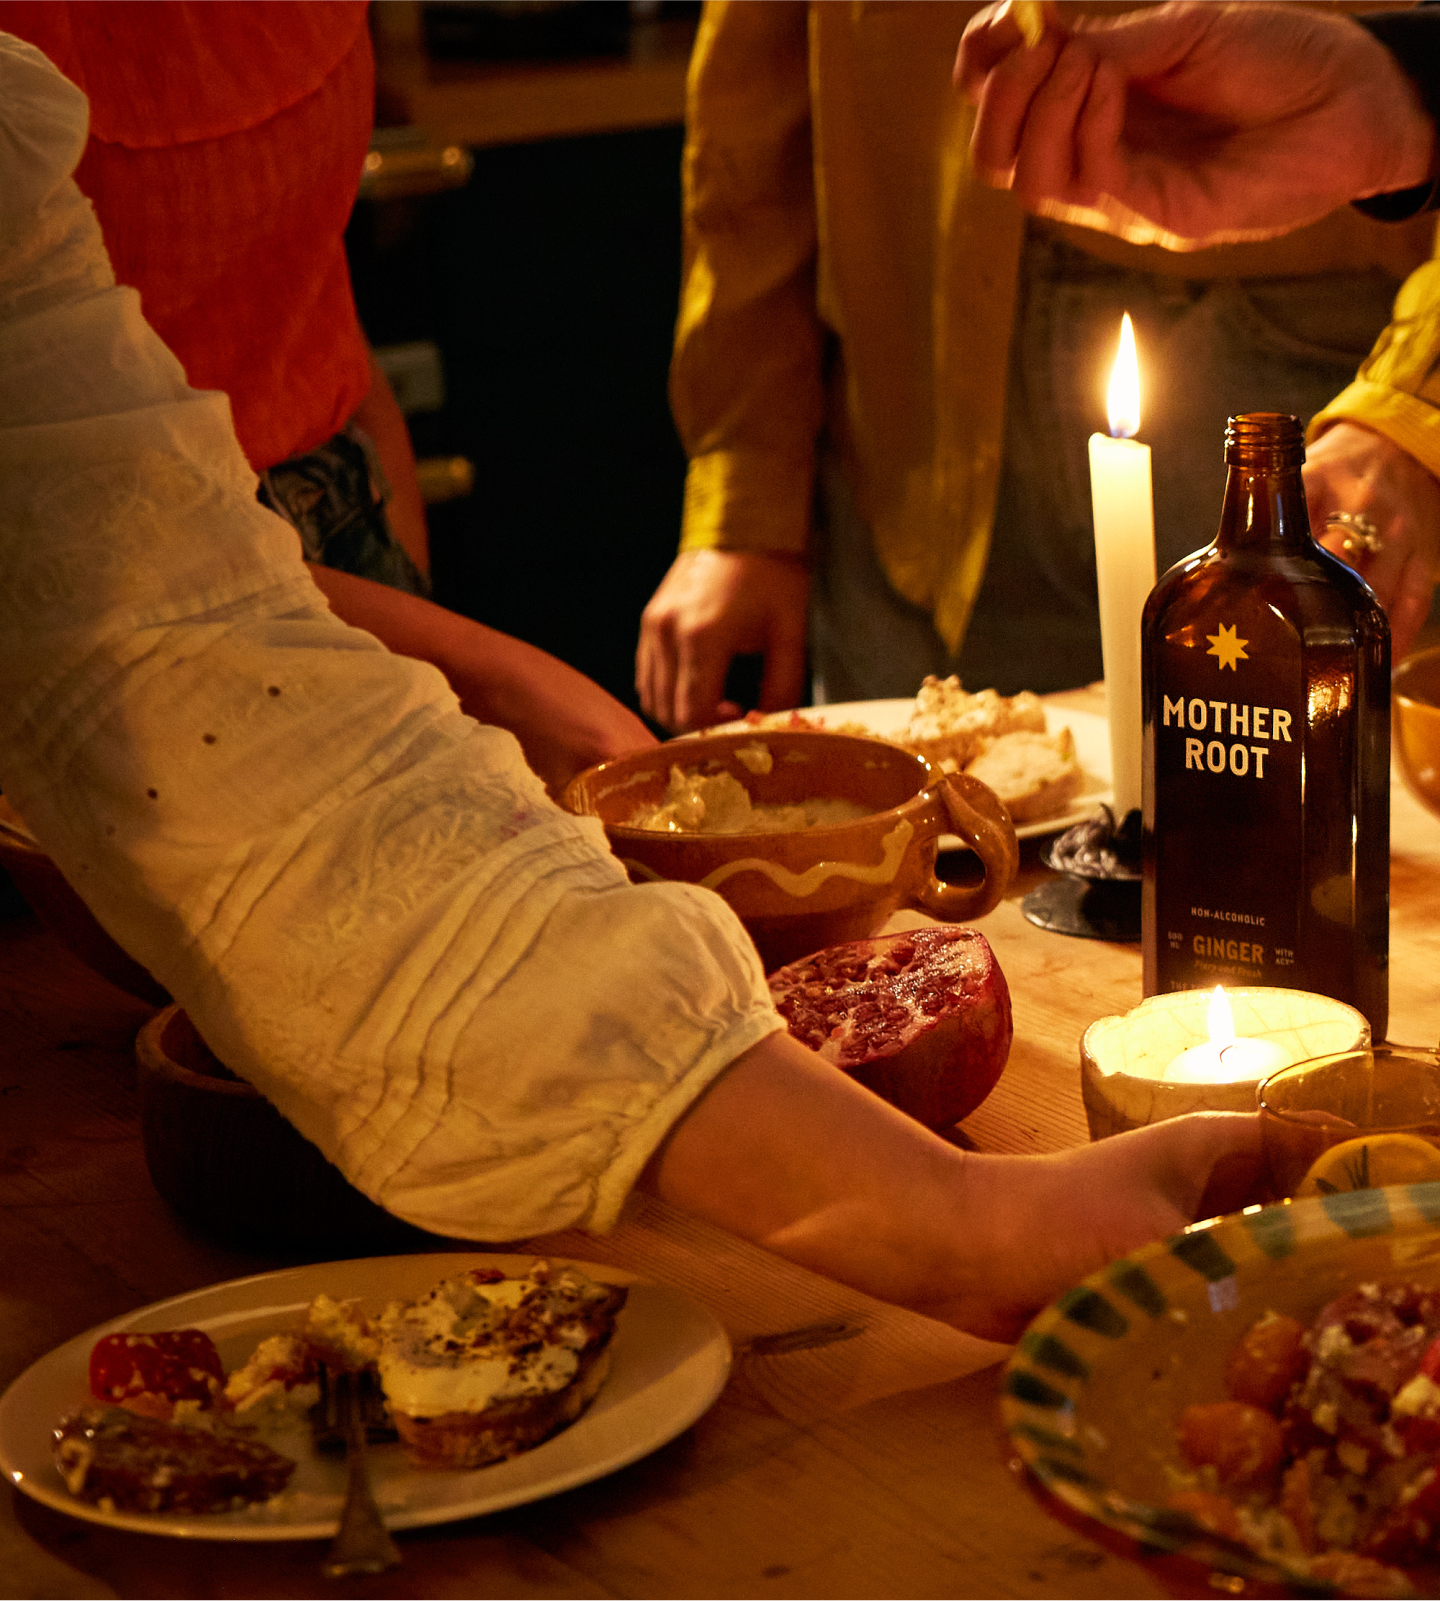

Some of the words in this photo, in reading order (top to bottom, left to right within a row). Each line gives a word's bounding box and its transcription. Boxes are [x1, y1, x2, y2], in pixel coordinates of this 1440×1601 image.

[1163, 694, 1292, 742] MOTHER
[1185, 737, 1269, 779] ROOT
[1191, 907, 1265, 926] NON-ALCOHOLIC
[1193, 935, 1264, 964] GINGER
